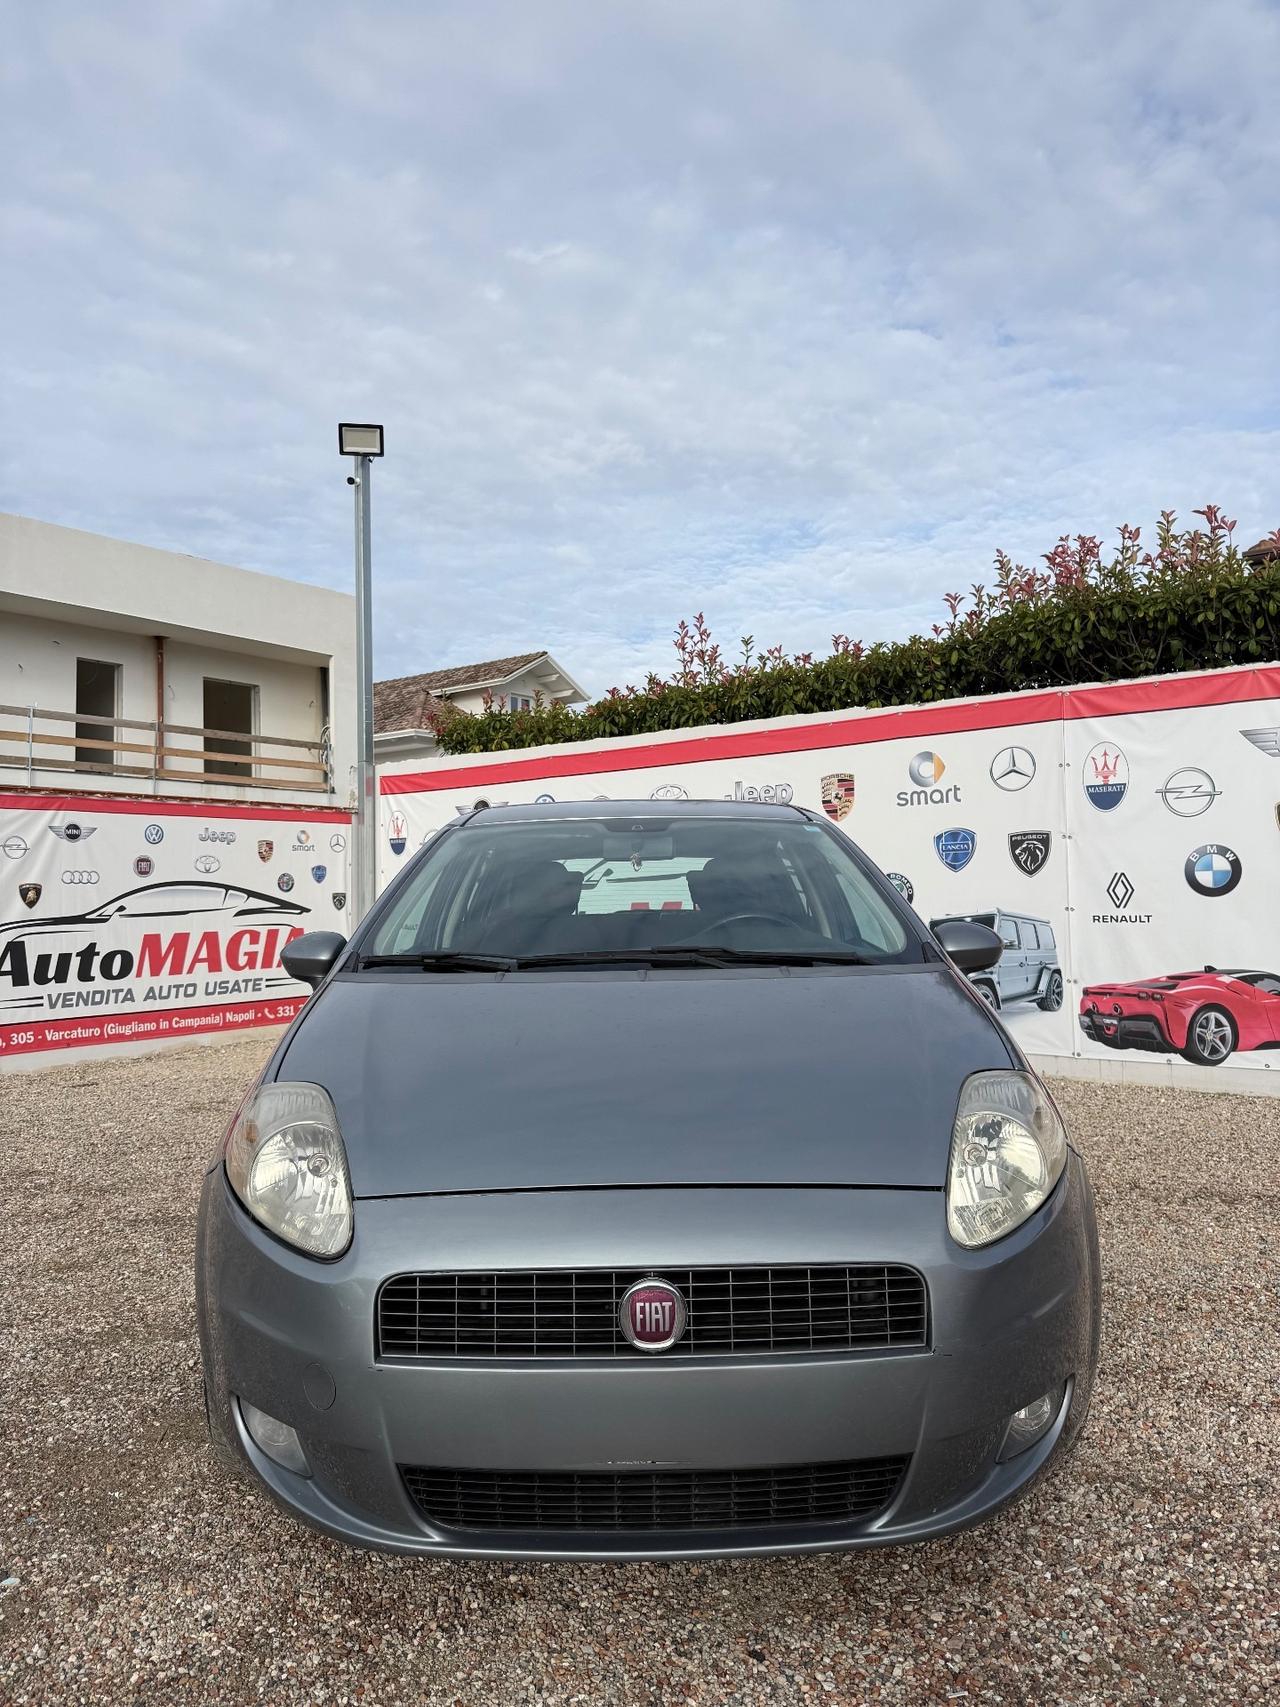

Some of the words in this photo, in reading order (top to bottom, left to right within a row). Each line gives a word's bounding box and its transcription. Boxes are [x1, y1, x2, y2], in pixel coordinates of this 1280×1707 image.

[1087, 784, 1125, 793] MASERATI
[896, 785, 961, 806] smart
[65, 828, 81, 836] MINI
[198, 827, 237, 845] Jeep
[1011, 833, 1047, 841] PEUGEOT
[291, 844, 316, 852] smart
[942, 843, 968, 851] LANCIA
[1189, 845, 1236, 862] BMW
[138, 861, 151, 872] FIAT
[1092, 914, 1153, 924] RENAULT
[47, 988, 136, 1010] VENDITA
[143, 982, 198, 1002] AUTO
[204, 977, 264, 996] USATE
[10, 1031, 35, 1046] 305
[45, 1026, 101, 1042] Varcaturo
[103, 1021, 157, 1039] (Giugliano
[159, 1018, 170, 1031] in
[172, 1011, 224, 1030] Campania)
[225, 1009, 256, 1024] Napoli
[276, 1005, 296, 1019] 331
[636, 1302, 672, 1332] FIAT
